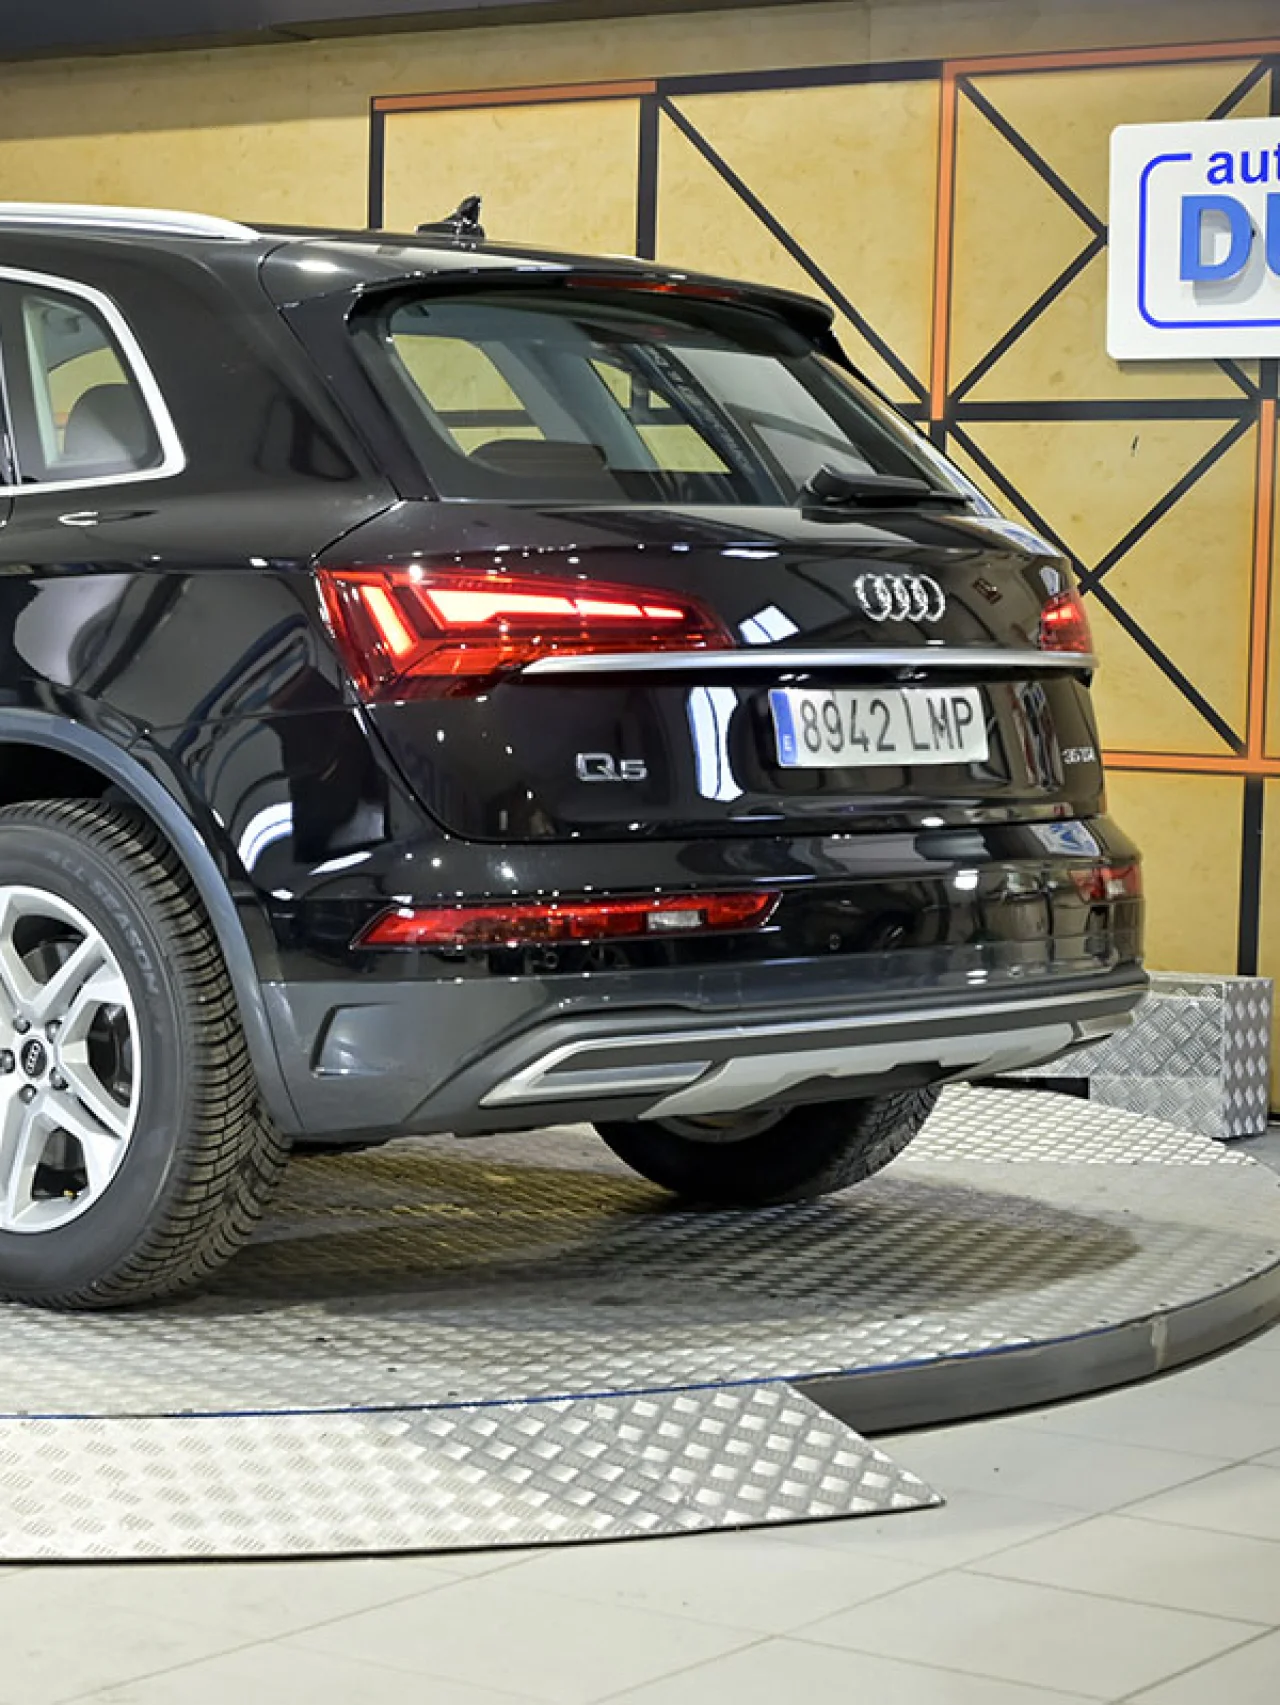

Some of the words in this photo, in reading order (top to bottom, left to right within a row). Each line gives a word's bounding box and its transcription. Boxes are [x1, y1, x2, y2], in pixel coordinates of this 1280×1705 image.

[1179, 192, 1280, 282] D
[800, 698, 897, 753] 8942
[901, 697, 974, 751] LMP
[576, 753, 647, 781] Q5
[89, 879, 161, 995] SEASON
